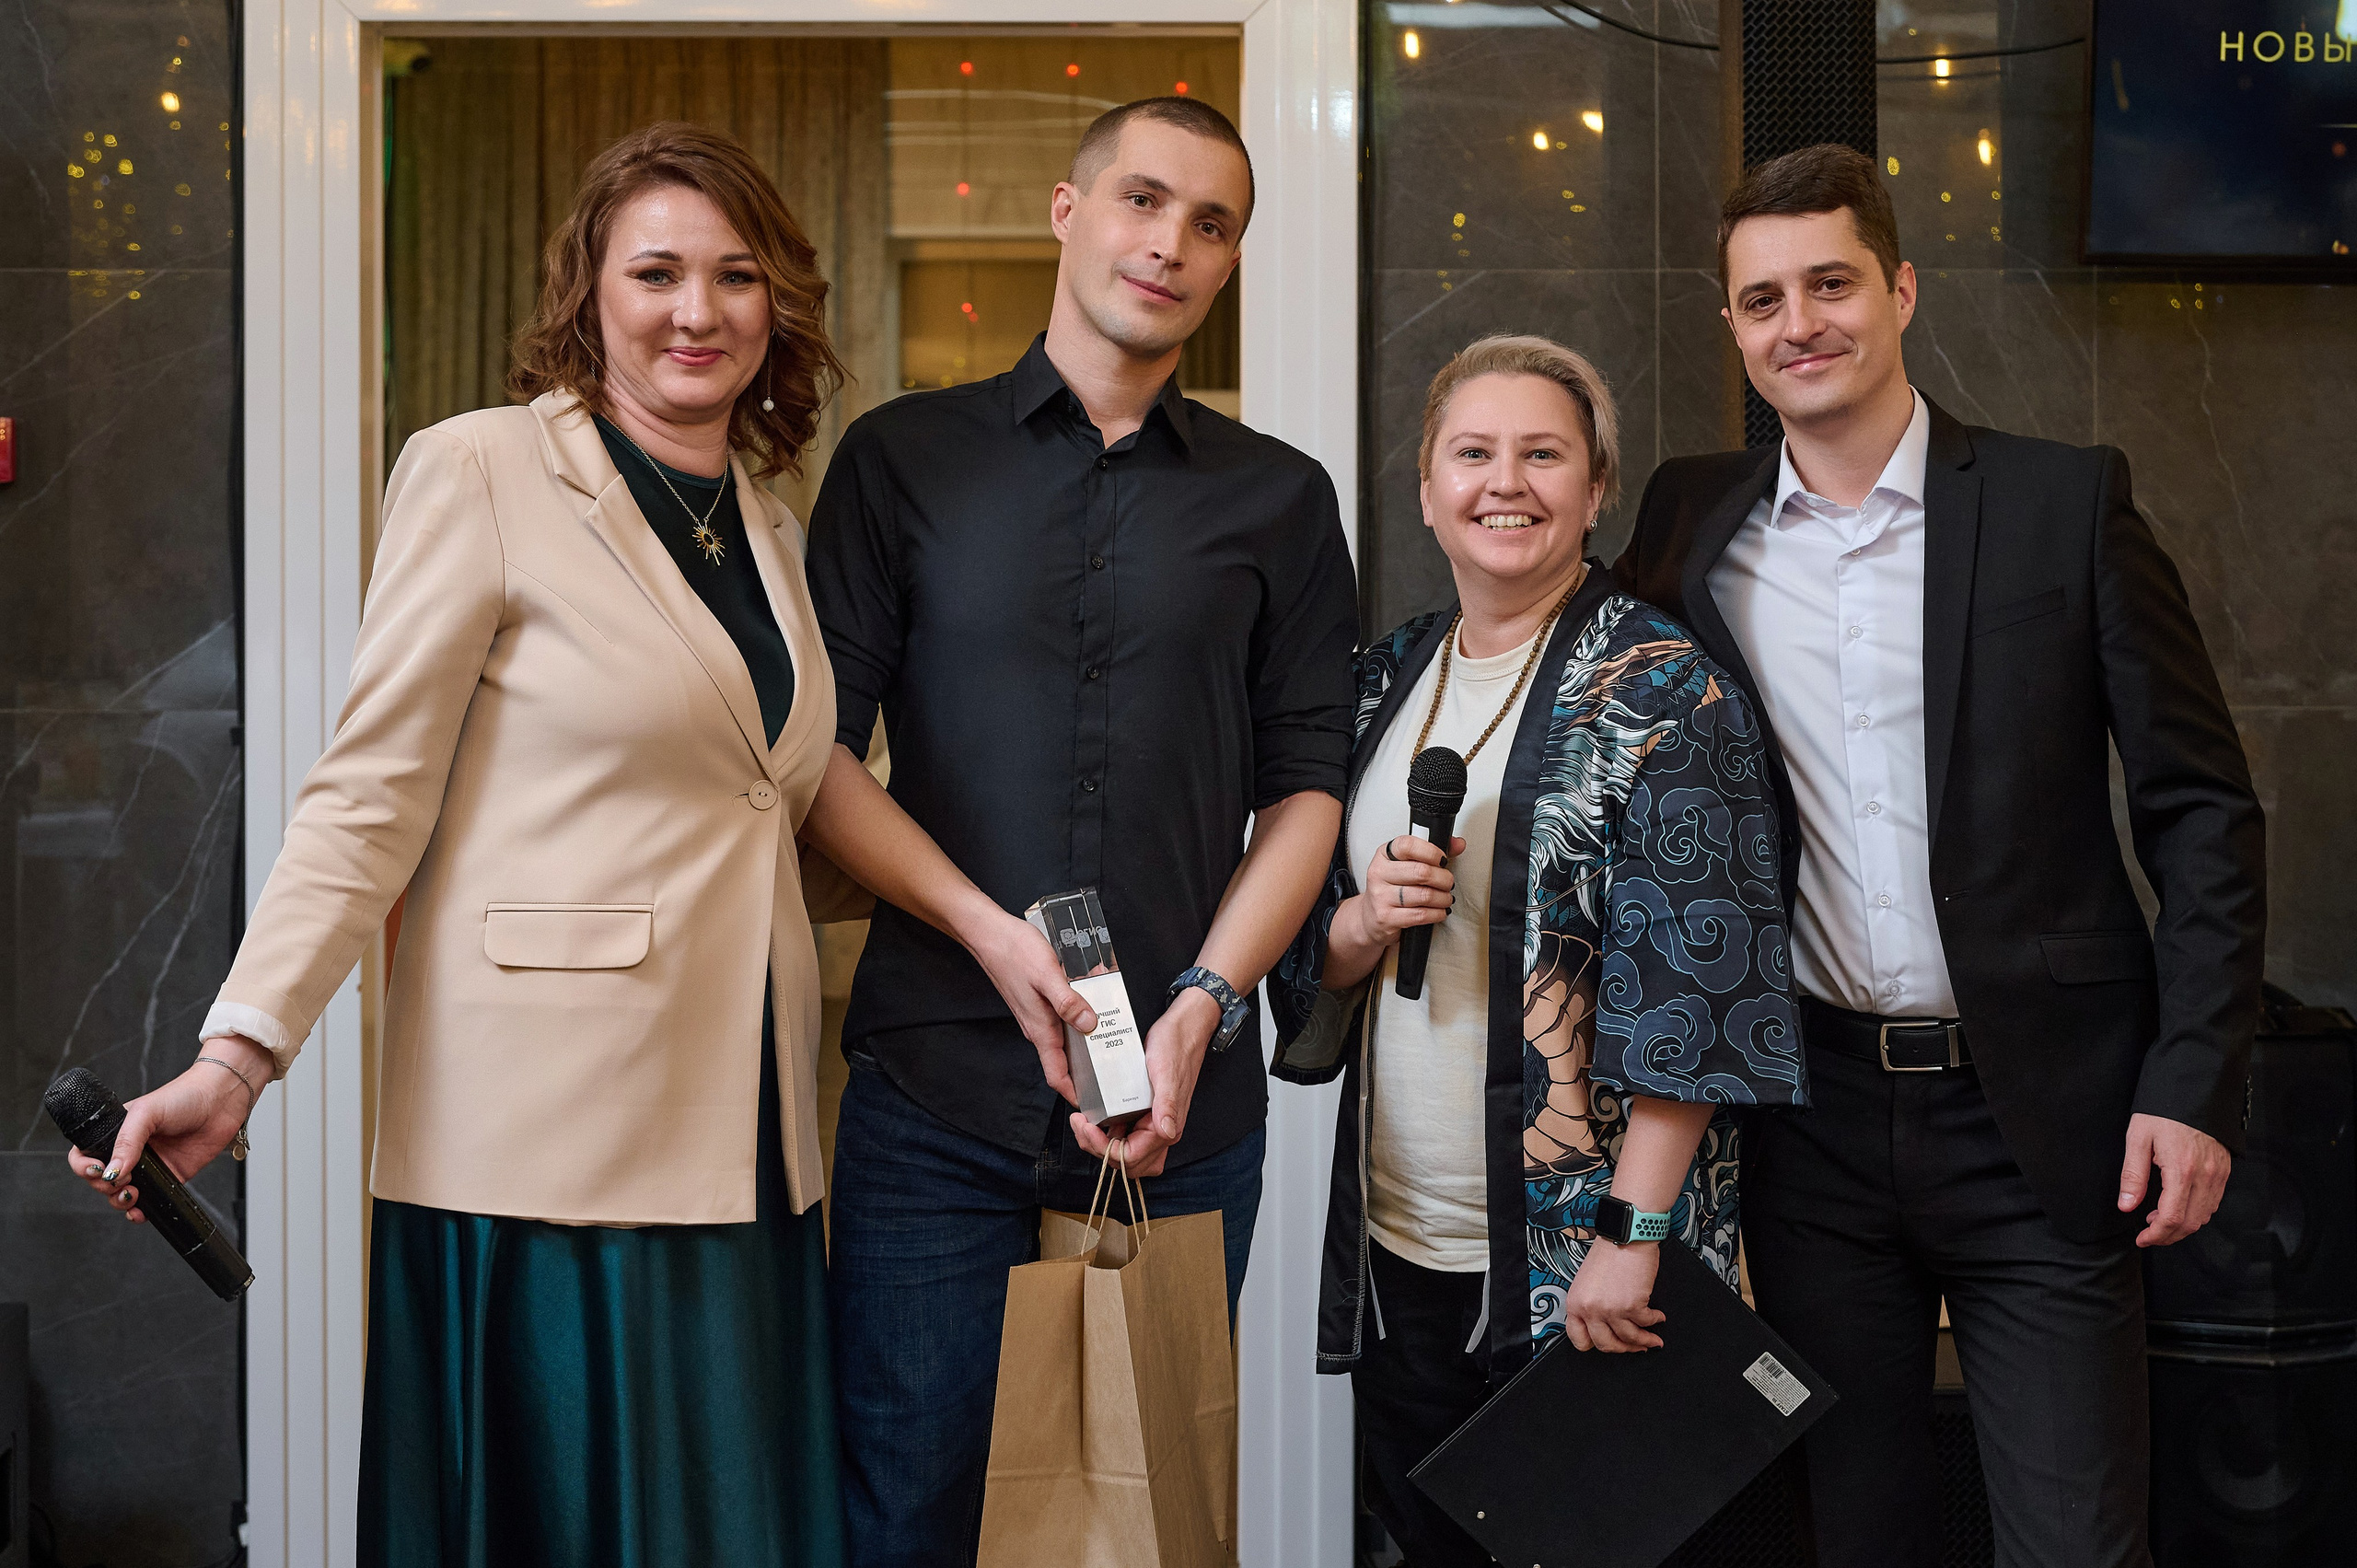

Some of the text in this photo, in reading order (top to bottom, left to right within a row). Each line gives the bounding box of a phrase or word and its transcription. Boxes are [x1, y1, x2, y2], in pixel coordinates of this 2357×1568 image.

[2220, 30, 2351, 63] НОВЫ
[1096, 1007, 1120, 1020] учший
[1100, 1018, 1117, 1028] ГИС
[1089, 1027, 1133, 1041] специалист
[1104, 1038, 1124, 1049] 2023
